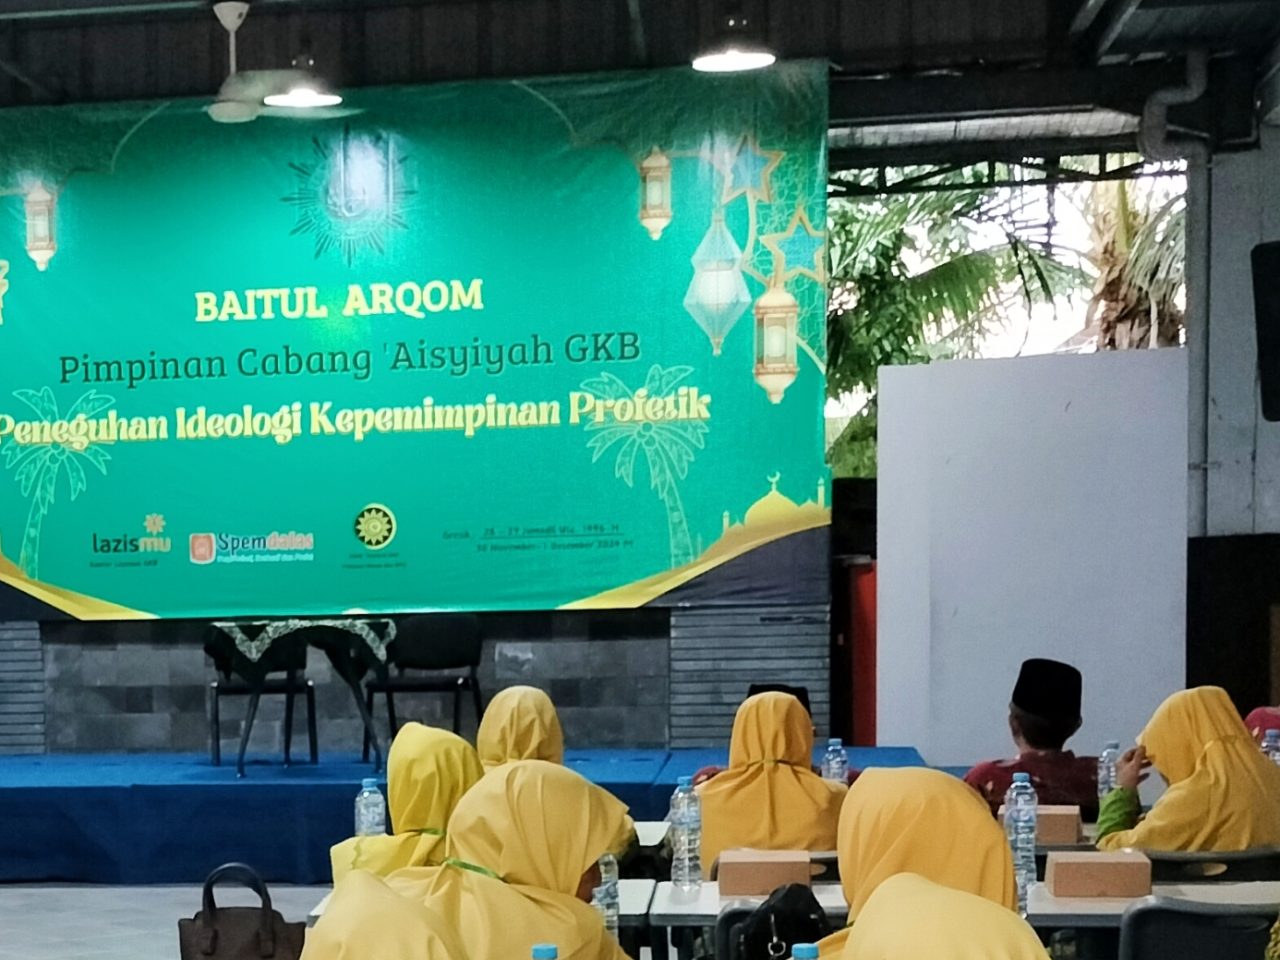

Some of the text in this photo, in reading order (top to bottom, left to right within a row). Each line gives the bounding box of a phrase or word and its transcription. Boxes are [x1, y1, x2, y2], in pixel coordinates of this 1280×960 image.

[194, 278, 484, 322] BAITUL ARQOM
[59, 332, 640, 389] Pimpinan Cabang 'Aisyiyah GKB
[176, 401, 302, 444] Ideologi
[310, 393, 561, 441] Kepemimpinan
[569, 386, 712, 423] Profetik
[92, 532, 172, 554] lazismu
[218, 531, 314, 556] Spemdalas
